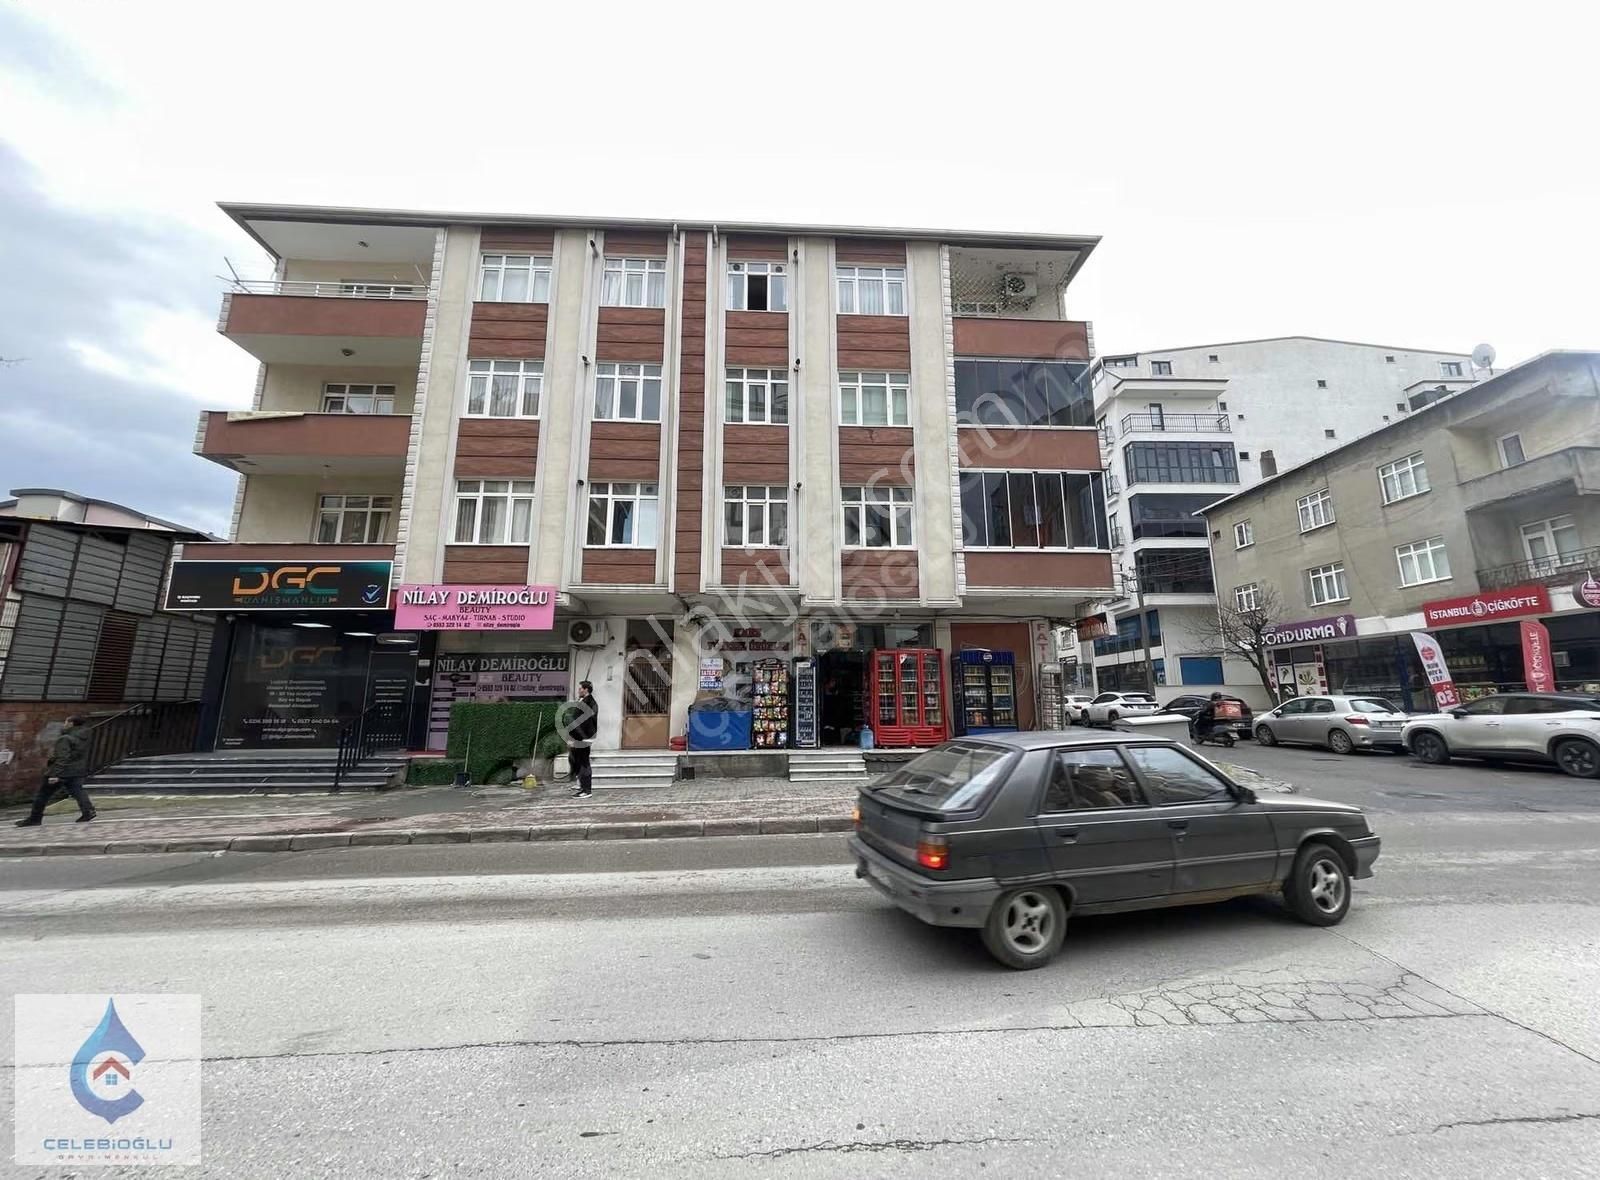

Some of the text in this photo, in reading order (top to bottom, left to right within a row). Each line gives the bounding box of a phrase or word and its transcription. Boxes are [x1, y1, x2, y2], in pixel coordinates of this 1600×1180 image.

[232, 566, 341, 596] DGC
[402, 586, 450, 605] NİLAY
[457, 585, 550, 605] DEMİROĞLU
[1429, 596, 1540, 620] İSTANBUL ÇİĞKÖFTE
[424, 614, 437, 622] SAÇ
[437, 656, 567, 671] NİLAY DEMİROĞLU
[502, 673, 543, 682] BEAUTY
